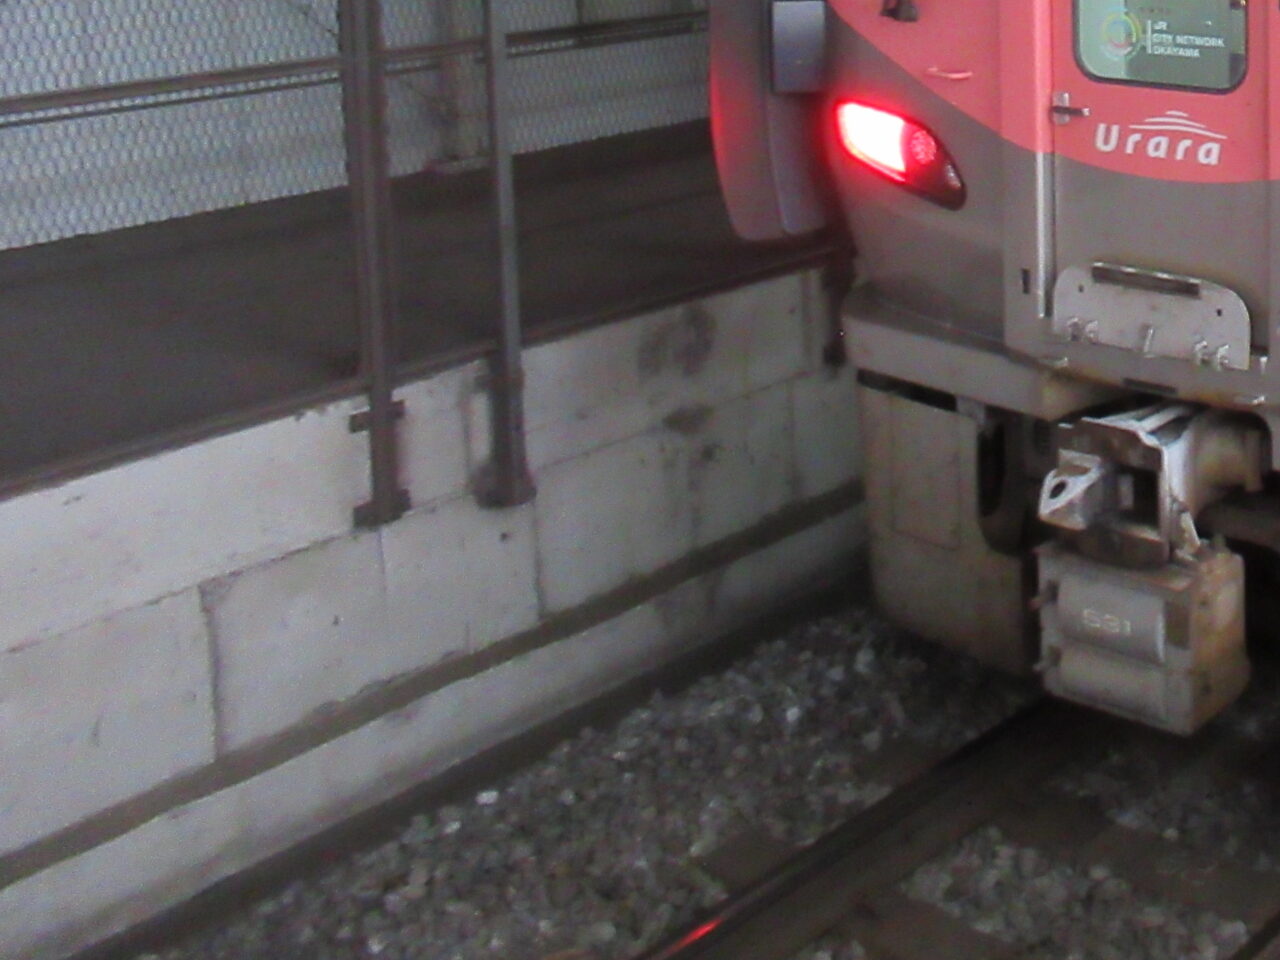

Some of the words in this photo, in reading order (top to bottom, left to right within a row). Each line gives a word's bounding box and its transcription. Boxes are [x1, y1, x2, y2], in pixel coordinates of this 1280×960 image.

[1153, 21, 1168, 30] JR
[1152, 34, 1173, 44] CITY
[1176, 35, 1225, 48] NETWORK
[1153, 46, 1200, 58] OKAYAMA
[1096, 123, 1221, 165] Urara
